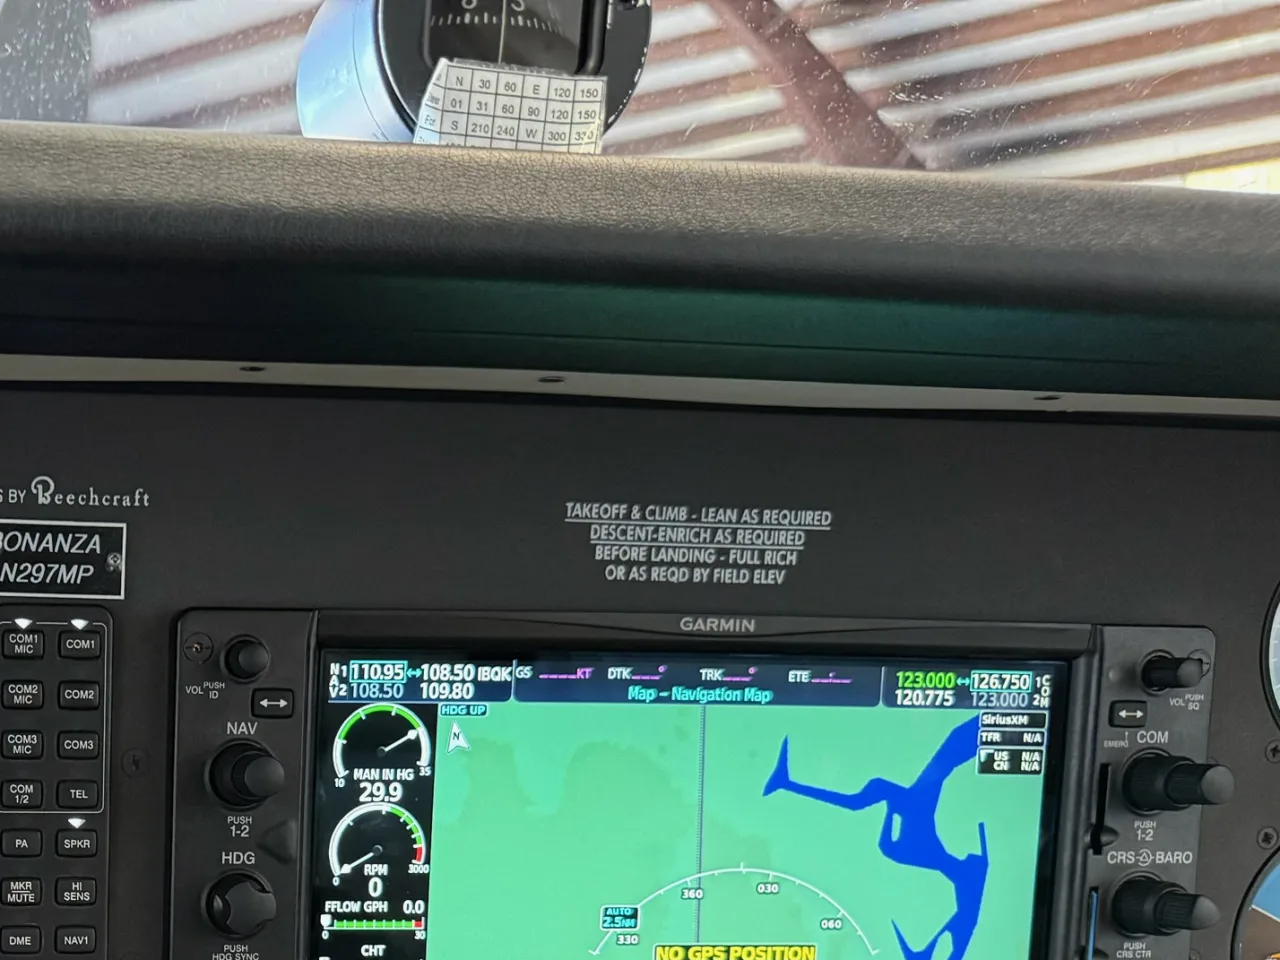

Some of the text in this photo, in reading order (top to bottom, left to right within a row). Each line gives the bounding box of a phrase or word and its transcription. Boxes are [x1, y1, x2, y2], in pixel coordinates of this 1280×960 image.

[478, 79, 598, 99] 30 60 120 150
[450, 98, 596, 120] 01 31 60 90 120 150
[471, 122, 566, 141] 210 240 300
[8, 488, 26, 503] BY
[31, 475, 150, 507] Beechcraft
[565, 502, 832, 526] TAKEOFF CLIMB LEAN AS REQUIRED
[590, 524, 805, 546] DESCENT-ENRICH AS REQUIRED
[595, 545, 797, 566] BEFORE LANDING FULL RICH
[0, 563, 94, 584] N297MP
[605, 565, 785, 585] OR AS REQD BY FIELD ELEV
[679, 617, 755, 633] GARMIN
[9, 634, 38, 643] COM1
[66, 640, 95, 649] COM1
[351, 664, 511, 682] 110.95 108.50 IBQK
[896, 671, 1030, 690] 123.000 126.750
[64, 690, 94, 699] COM2
[350, 684, 475, 699] 108.50 109.80
[628, 686, 773, 704] Map Navigation Map
[895, 690, 1028, 707] 120.775 123.000
[982, 714, 1029, 725] SiriusXM
[226, 722, 258, 735] NAV
[64, 740, 94, 750] COM3
[359, 782, 403, 802] 29.9
[64, 839, 90, 849] SPKR
[221, 851, 256, 865] HDG
[1156, 852, 1193, 865] BARO
[364, 864, 388, 876] RPM
[7, 893, 35, 903] MUTE
[63, 892, 90, 901] SENS
[325, 901, 388, 913] FFLOW GPH
[64, 936, 89, 945] NAV1
[361, 945, 386, 957] CHT
